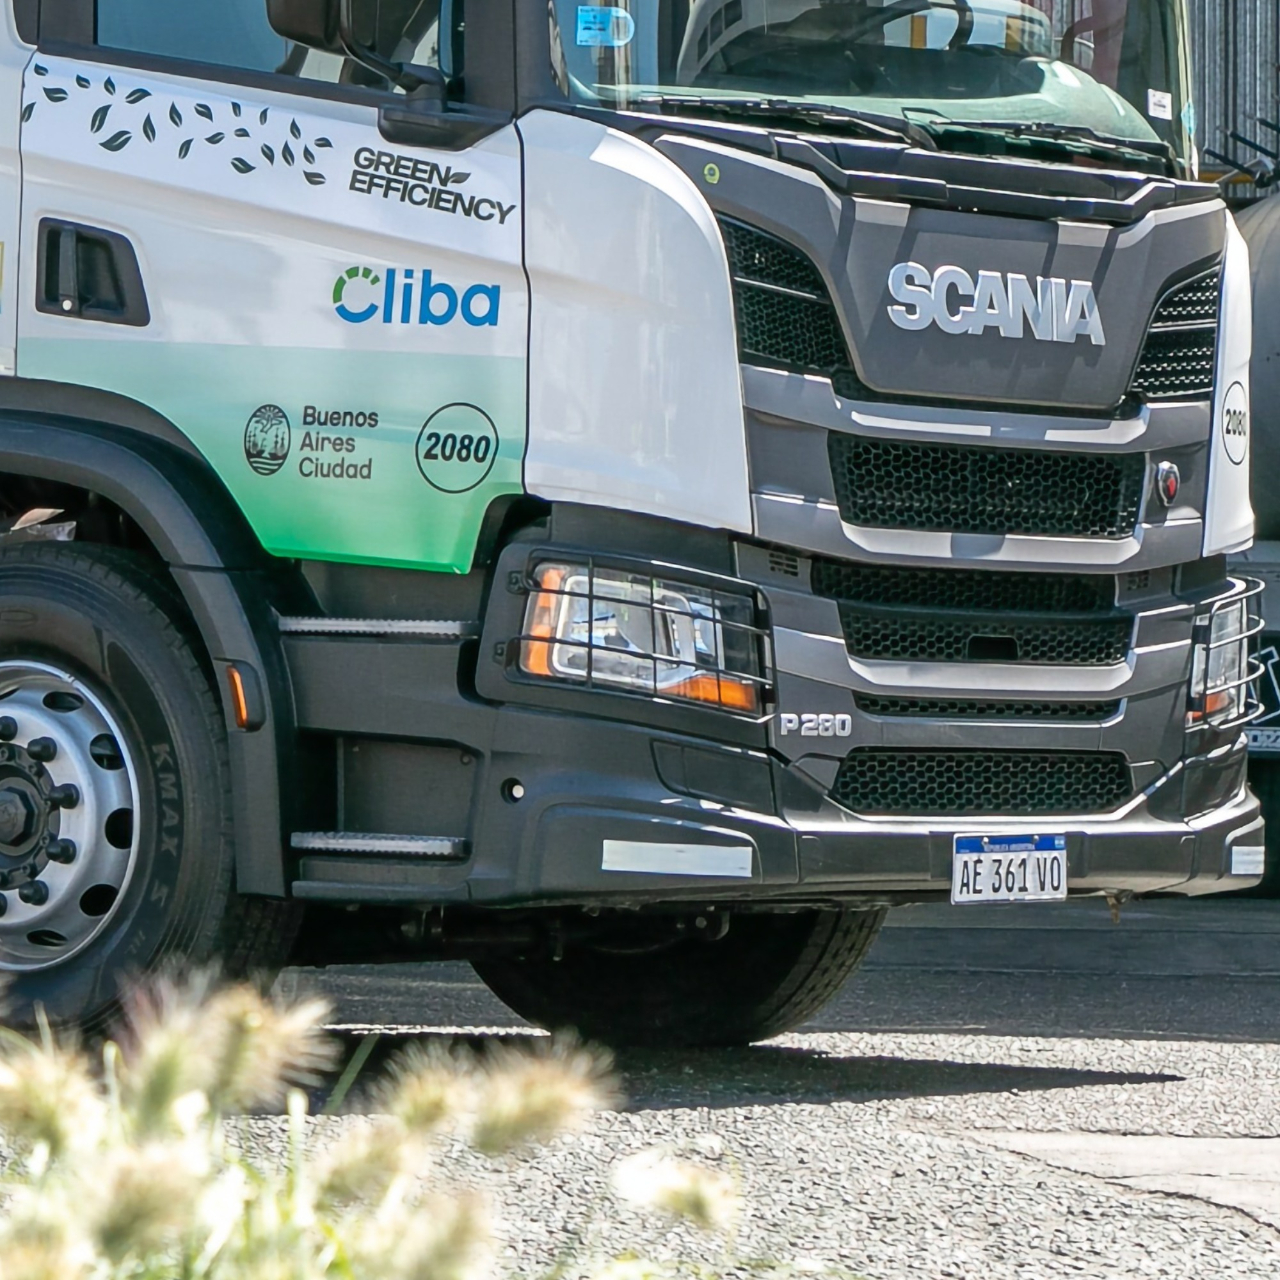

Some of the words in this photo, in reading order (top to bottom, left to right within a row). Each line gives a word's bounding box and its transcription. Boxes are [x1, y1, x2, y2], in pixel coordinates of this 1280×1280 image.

[353, 146, 452, 188] GREEN
[348, 169, 518, 225] EFFICIENCY
[332, 265, 501, 327] Cliba
[886, 261, 1107, 346] SCANIA
[302, 404, 379, 428] Buenos
[299, 431, 356, 453] Aires
[423, 431, 491, 464] 2080
[298, 456, 373, 480] Ciudad
[959, 857, 984, 895] AE
[991, 857, 1029, 894] 361
[1036, 855, 1061, 892] VO
